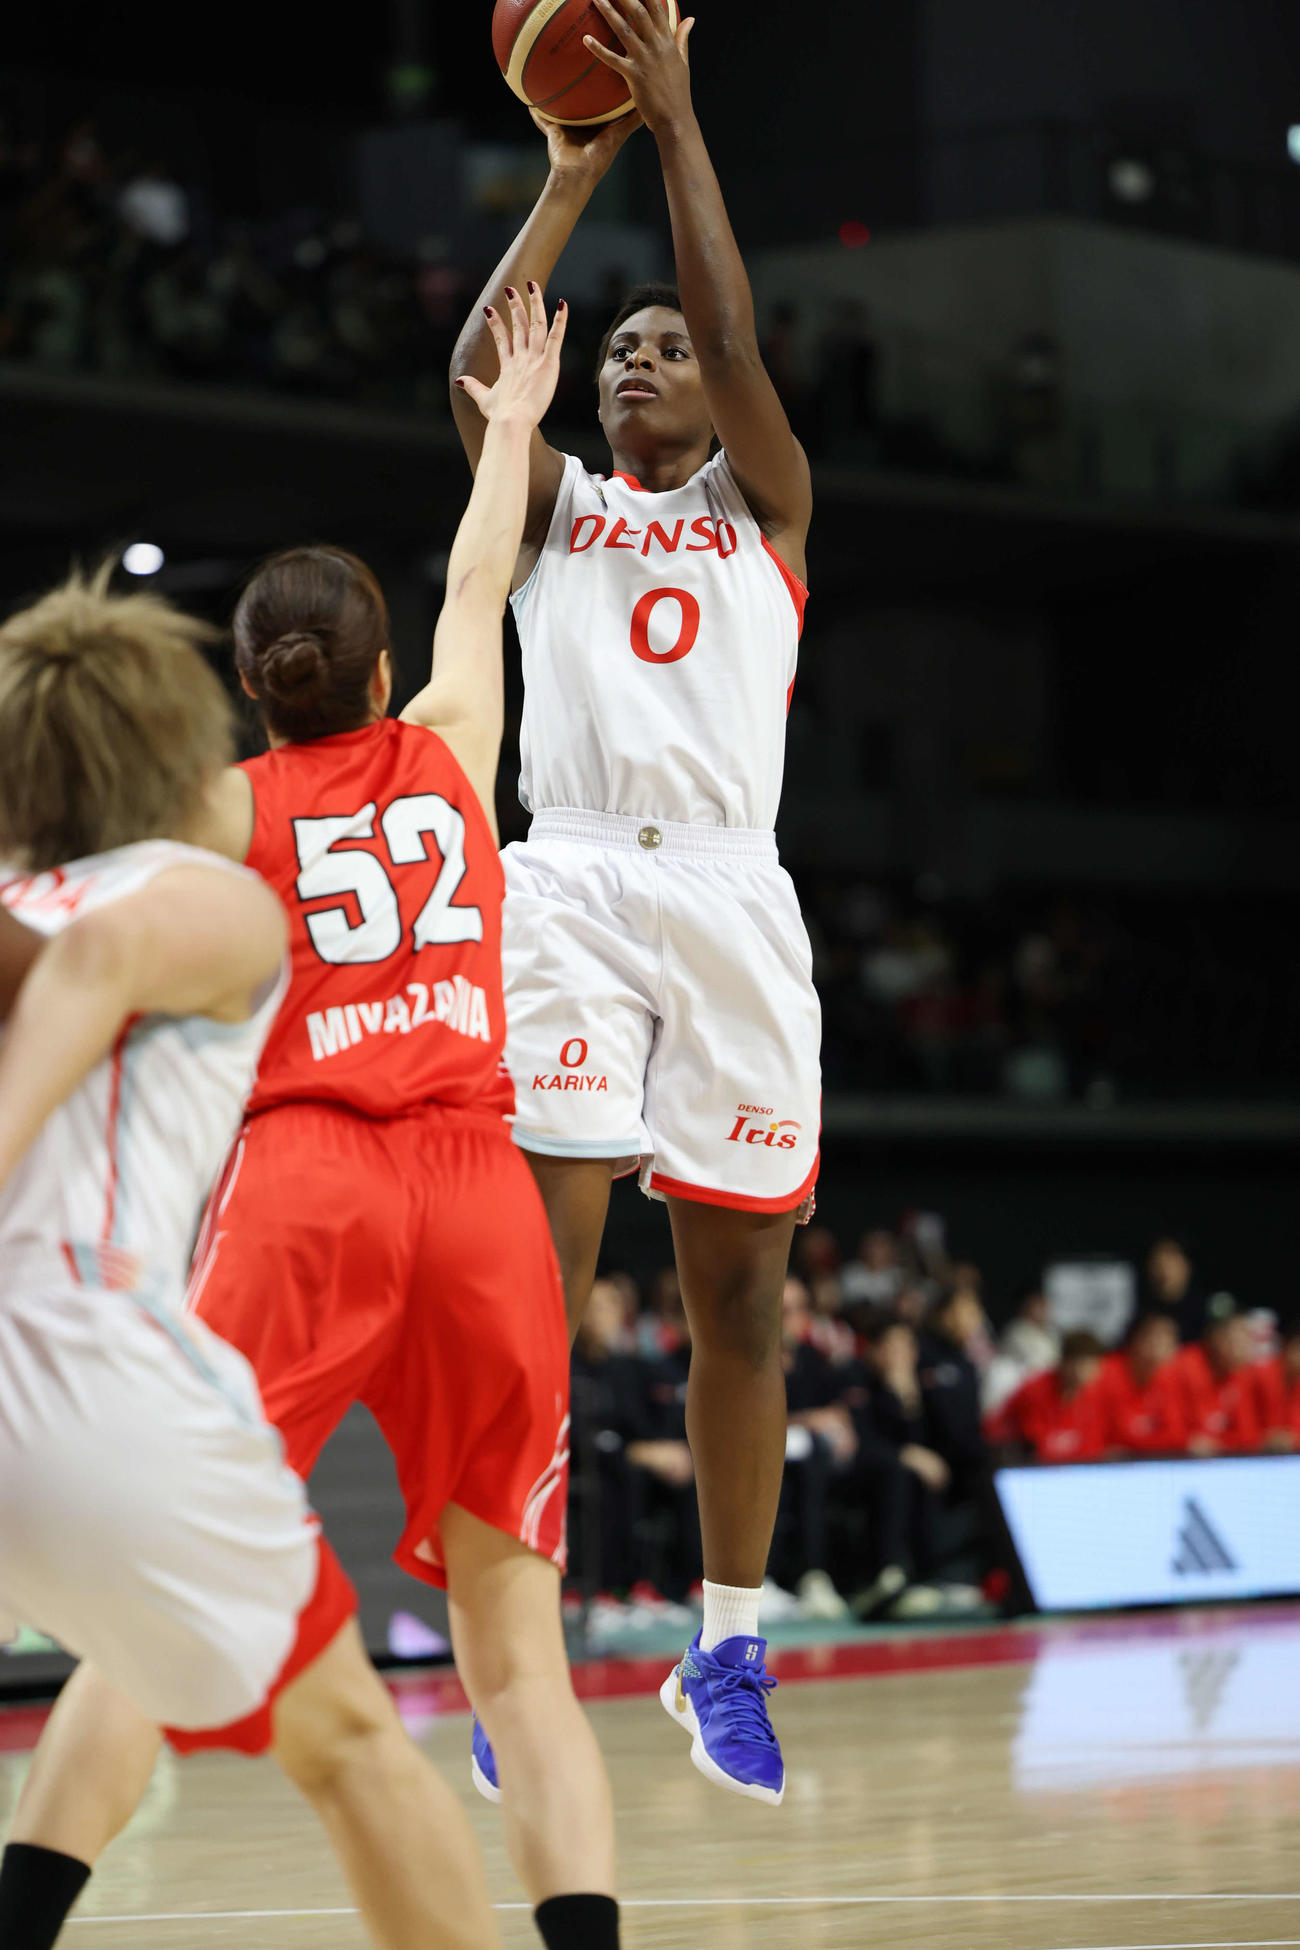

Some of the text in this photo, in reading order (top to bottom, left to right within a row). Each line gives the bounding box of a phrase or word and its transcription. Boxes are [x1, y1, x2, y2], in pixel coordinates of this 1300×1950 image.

[569, 514, 737, 560] DENSO
[291, 792, 483, 966] 52
[532, 1074, 607, 1092] KARIYA
[736, 1103, 774, 1116] DENSO
[723, 1115, 797, 1149] Iris
